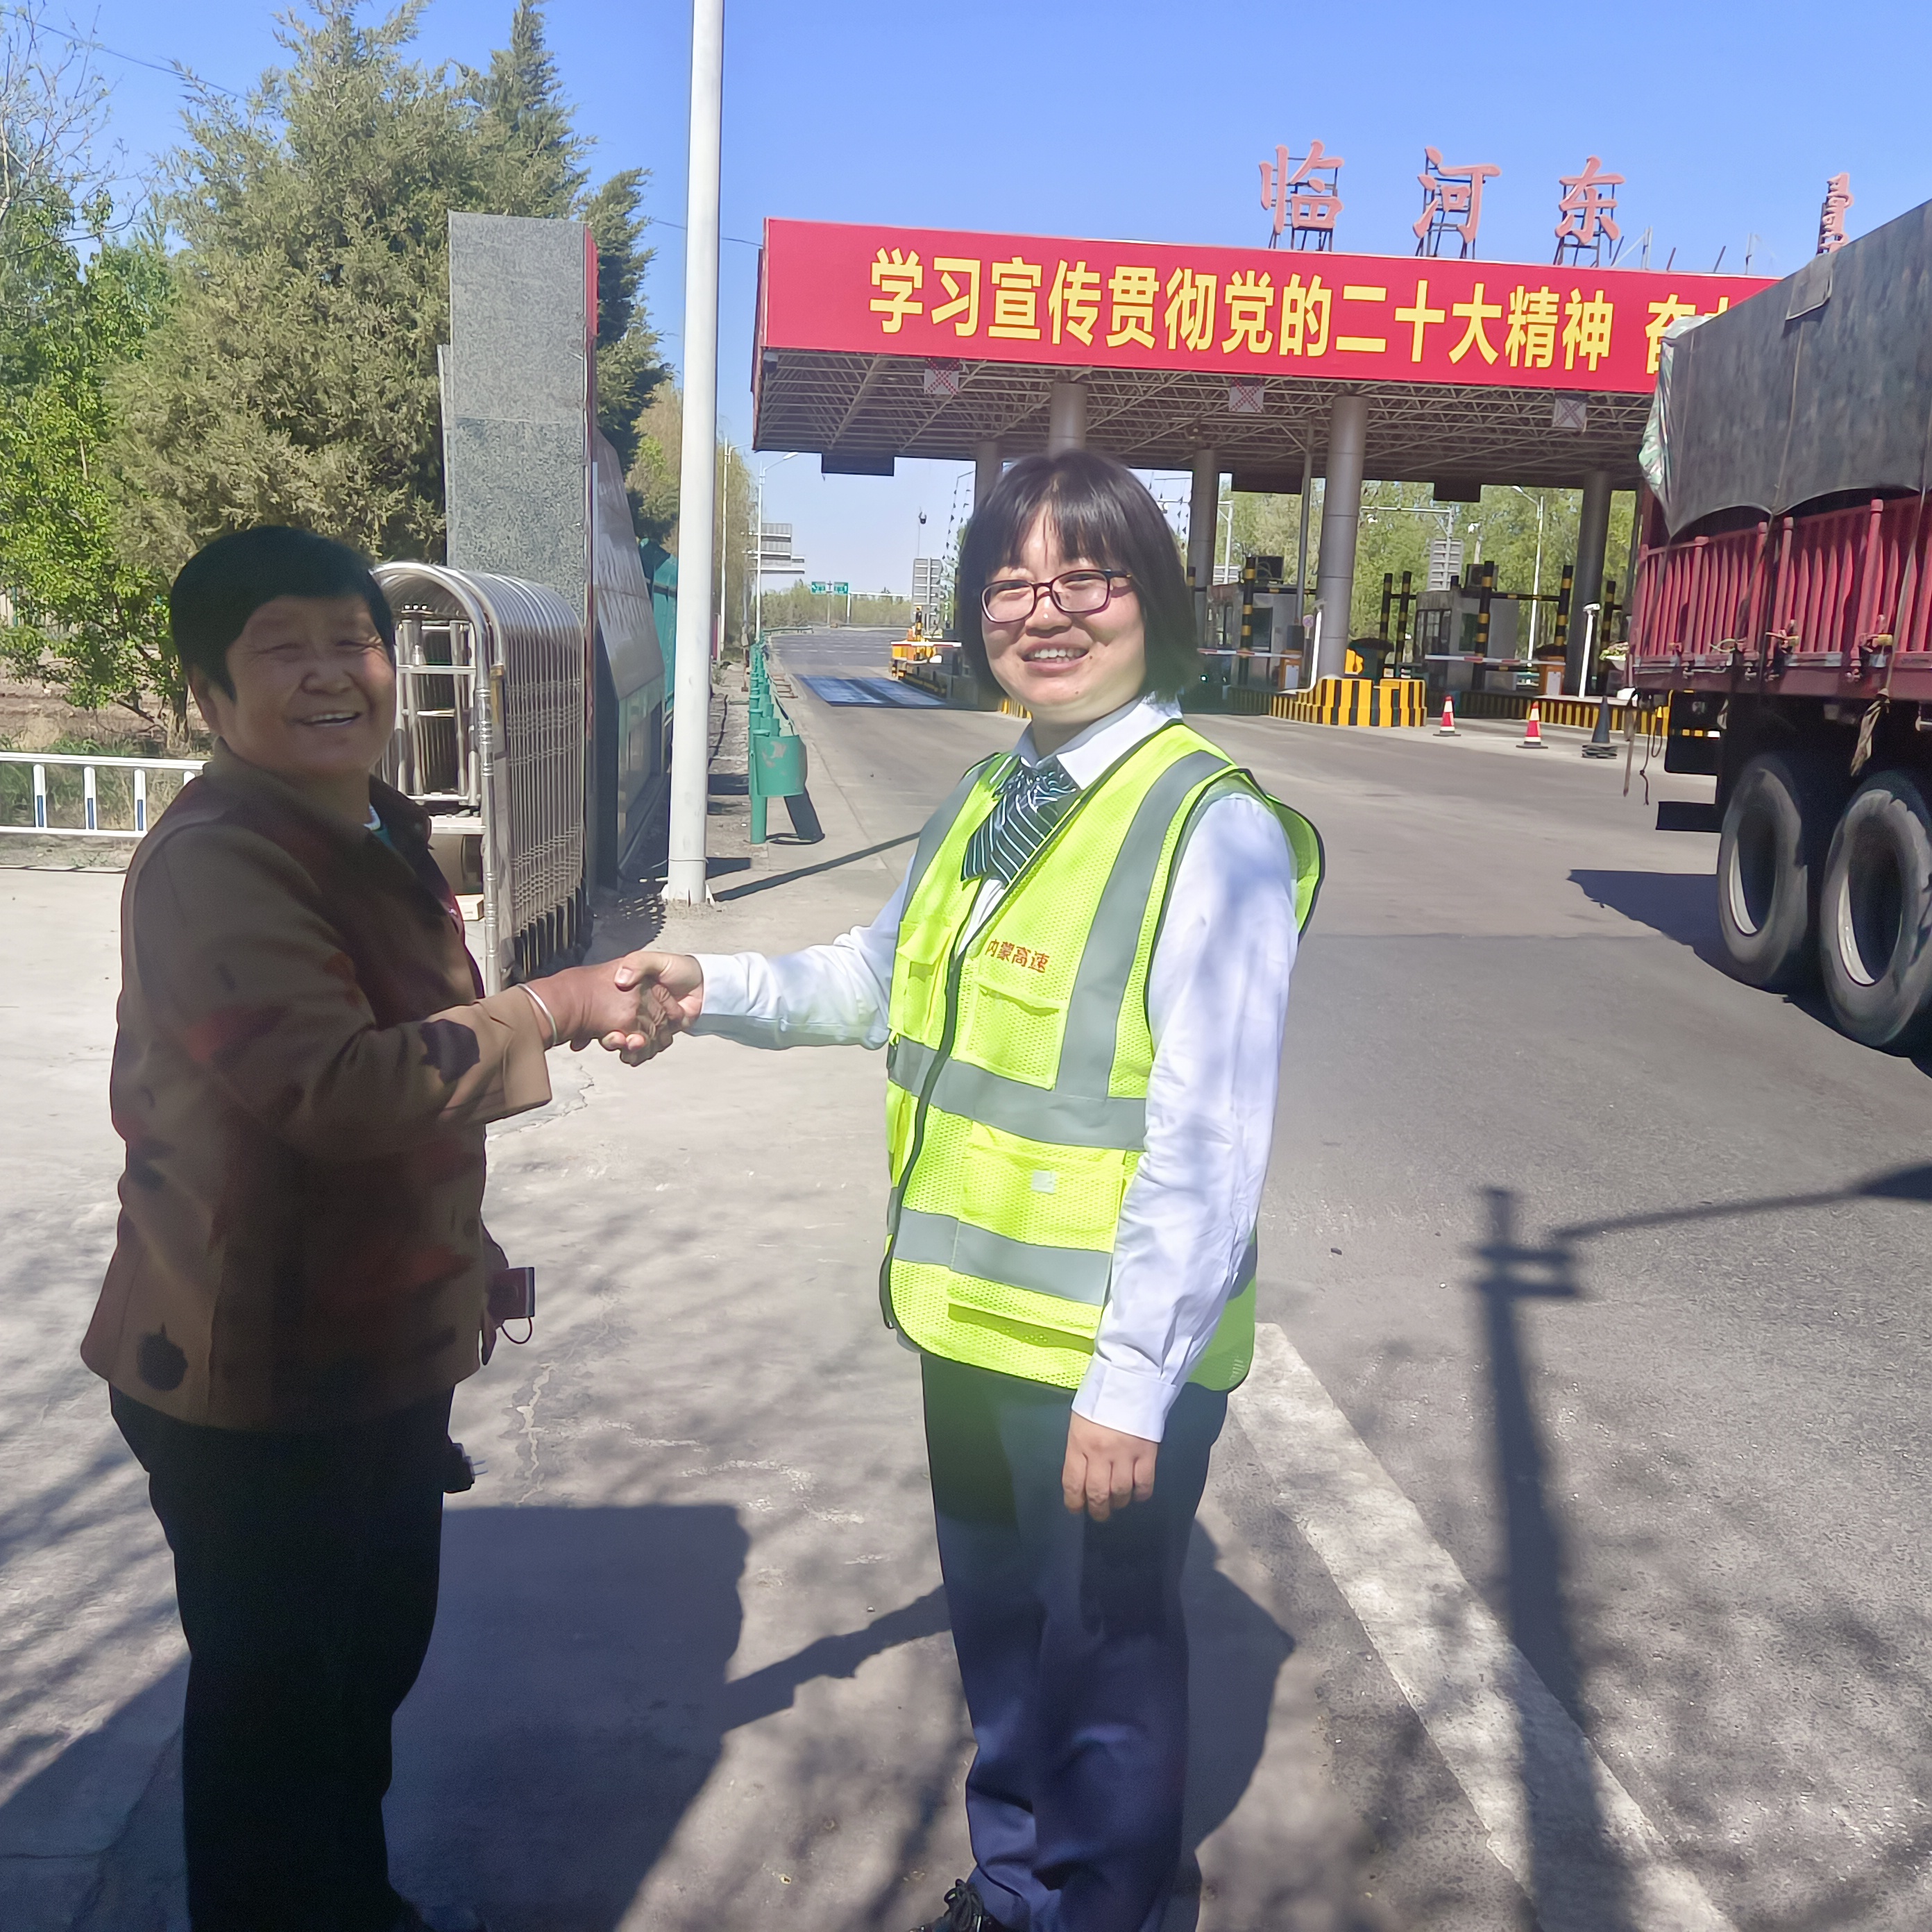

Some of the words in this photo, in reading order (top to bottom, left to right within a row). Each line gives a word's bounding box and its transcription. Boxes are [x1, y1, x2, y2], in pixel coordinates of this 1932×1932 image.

[1260, 139, 1625, 244] 临河东
[870, 248, 1613, 371] 学习宣传贯彻党的二十大精神
[985, 939, 1049, 973] 内蒙高速
